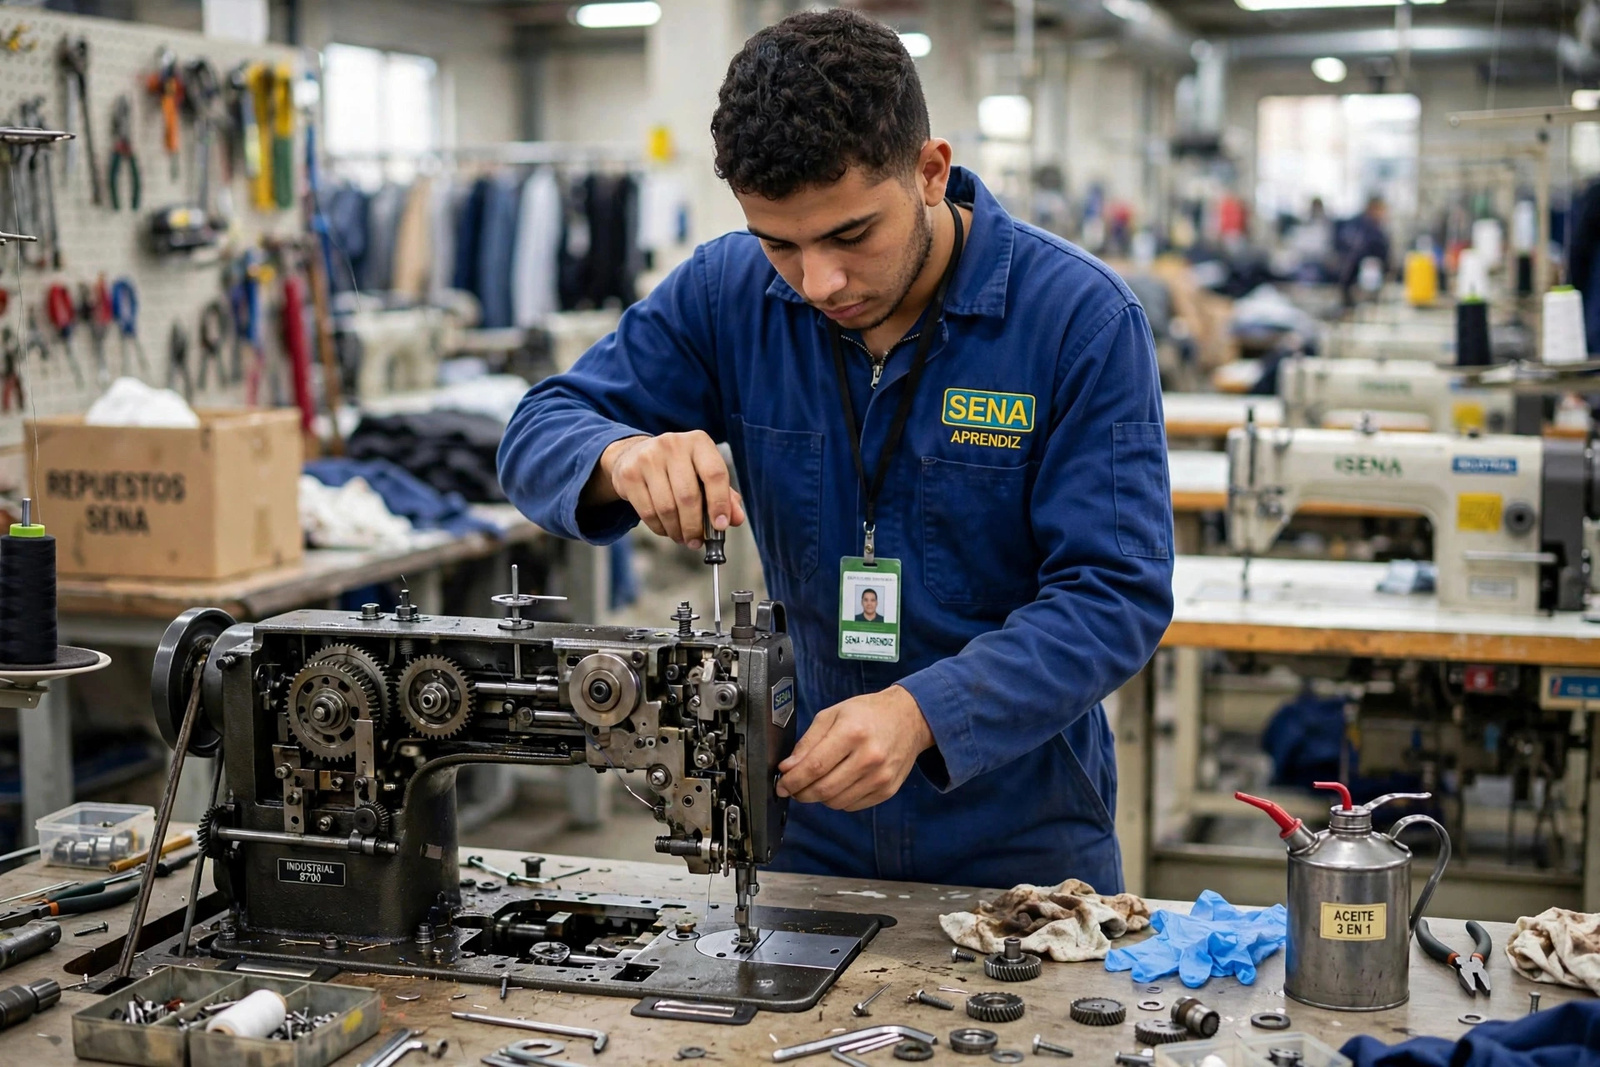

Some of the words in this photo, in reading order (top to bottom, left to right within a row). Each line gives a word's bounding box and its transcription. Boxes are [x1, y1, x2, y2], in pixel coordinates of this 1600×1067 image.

[948, 394, 1028, 426] SENA
[950, 430, 1021, 449] APRENDIZ
[47, 469, 186, 504] REPUESTOS
[85, 504, 150, 535] SENA
[845, 635, 860, 645] SENA
[865, 636, 893, 647] APRENDIZ
[286, 861, 335, 874] INDUSTRIAL
[299, 872, 321, 883] 8700
[1334, 910, 1375, 922] ACEITE
[1337, 923, 1343, 934] 3
[1347, 924, 1362, 935] EN
[1366, 924, 1371, 935] 1
